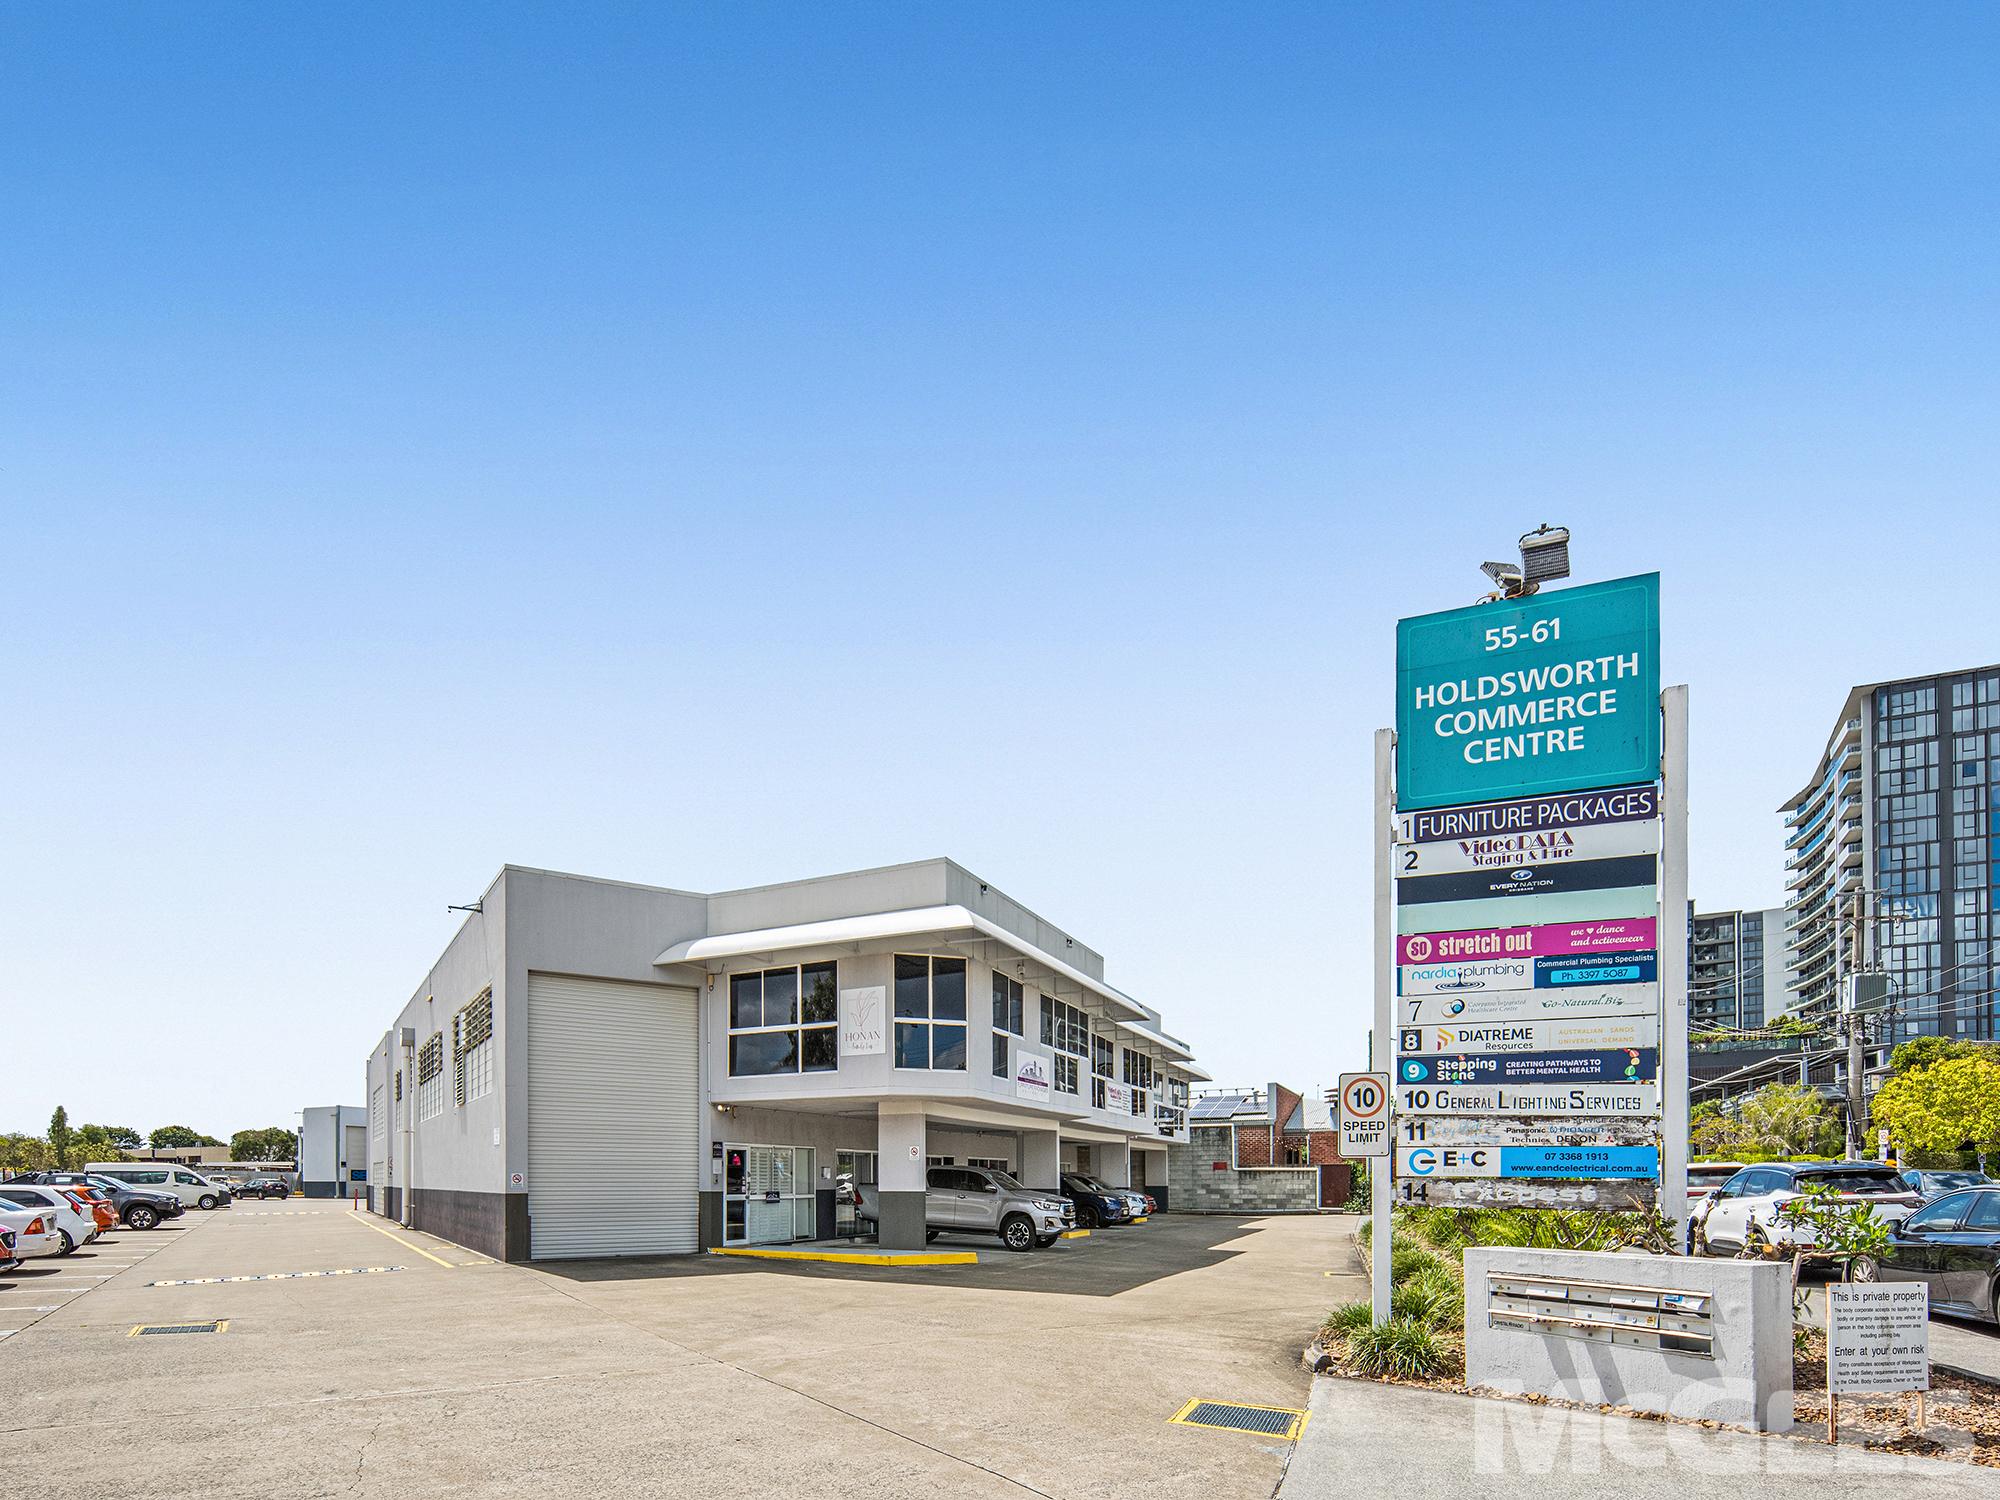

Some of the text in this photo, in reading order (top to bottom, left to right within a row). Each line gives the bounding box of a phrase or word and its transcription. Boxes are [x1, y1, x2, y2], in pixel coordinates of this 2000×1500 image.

[1485, 618, 1560, 651] 55-61
[1415, 652, 1639, 710] HOLDSWORTH
[1434, 689, 1617, 737] COMMERCE
[1463, 726, 1585, 764] CENTRE
[1402, 792, 1652, 838] 1 FURNITURE PACKAGES
[1404, 850, 1418, 870] 2
[1472, 848, 1574, 867] Staging & Hire
[1489, 879, 1554, 890] EVERY NATION
[1596, 925, 1625, 934] dance
[1410, 931, 1532, 956] SO stretch out
[1570, 935, 1645, 946] and activewear
[1537, 954, 1654, 968] Commercial Plumbing Specialists
[1411, 964, 1525, 980] nardia plumbing
[1561, 969, 1628, 980] Ph. 3397 5087
[1408, 1000, 1423, 1021] 7
[1458, 1028, 1533, 1042] DIATREME
[1404, 1034, 1418, 1051] 8
[1485, 1042, 1534, 1051] Resources
[1437, 1058, 1497, 1071] Stepping
[1505, 1060, 1545, 1068] CREATING
[1590, 1058, 1602, 1066] TO
[1408, 1064, 1420, 1078] 9
[1353, 1087, 1375, 1108] 10
[1404, 1090, 1641, 1109] 10 GENERAL LIGHTING SERVICES
[1343, 1121, 1386, 1131] SPEED
[1404, 1122, 1426, 1140] 11
[1348, 1133, 1381, 1143] LIMIT
[1545, 1152, 1609, 1161] 07 3368 1913
[1510, 1164, 1648, 1173] www.eandcelectrical.com.au
[1402, 1183, 1428, 1201] 14
[1832, 1291, 1926, 1303] This is private property
[1835, 1344, 1925, 1358] Enter at your own risk
